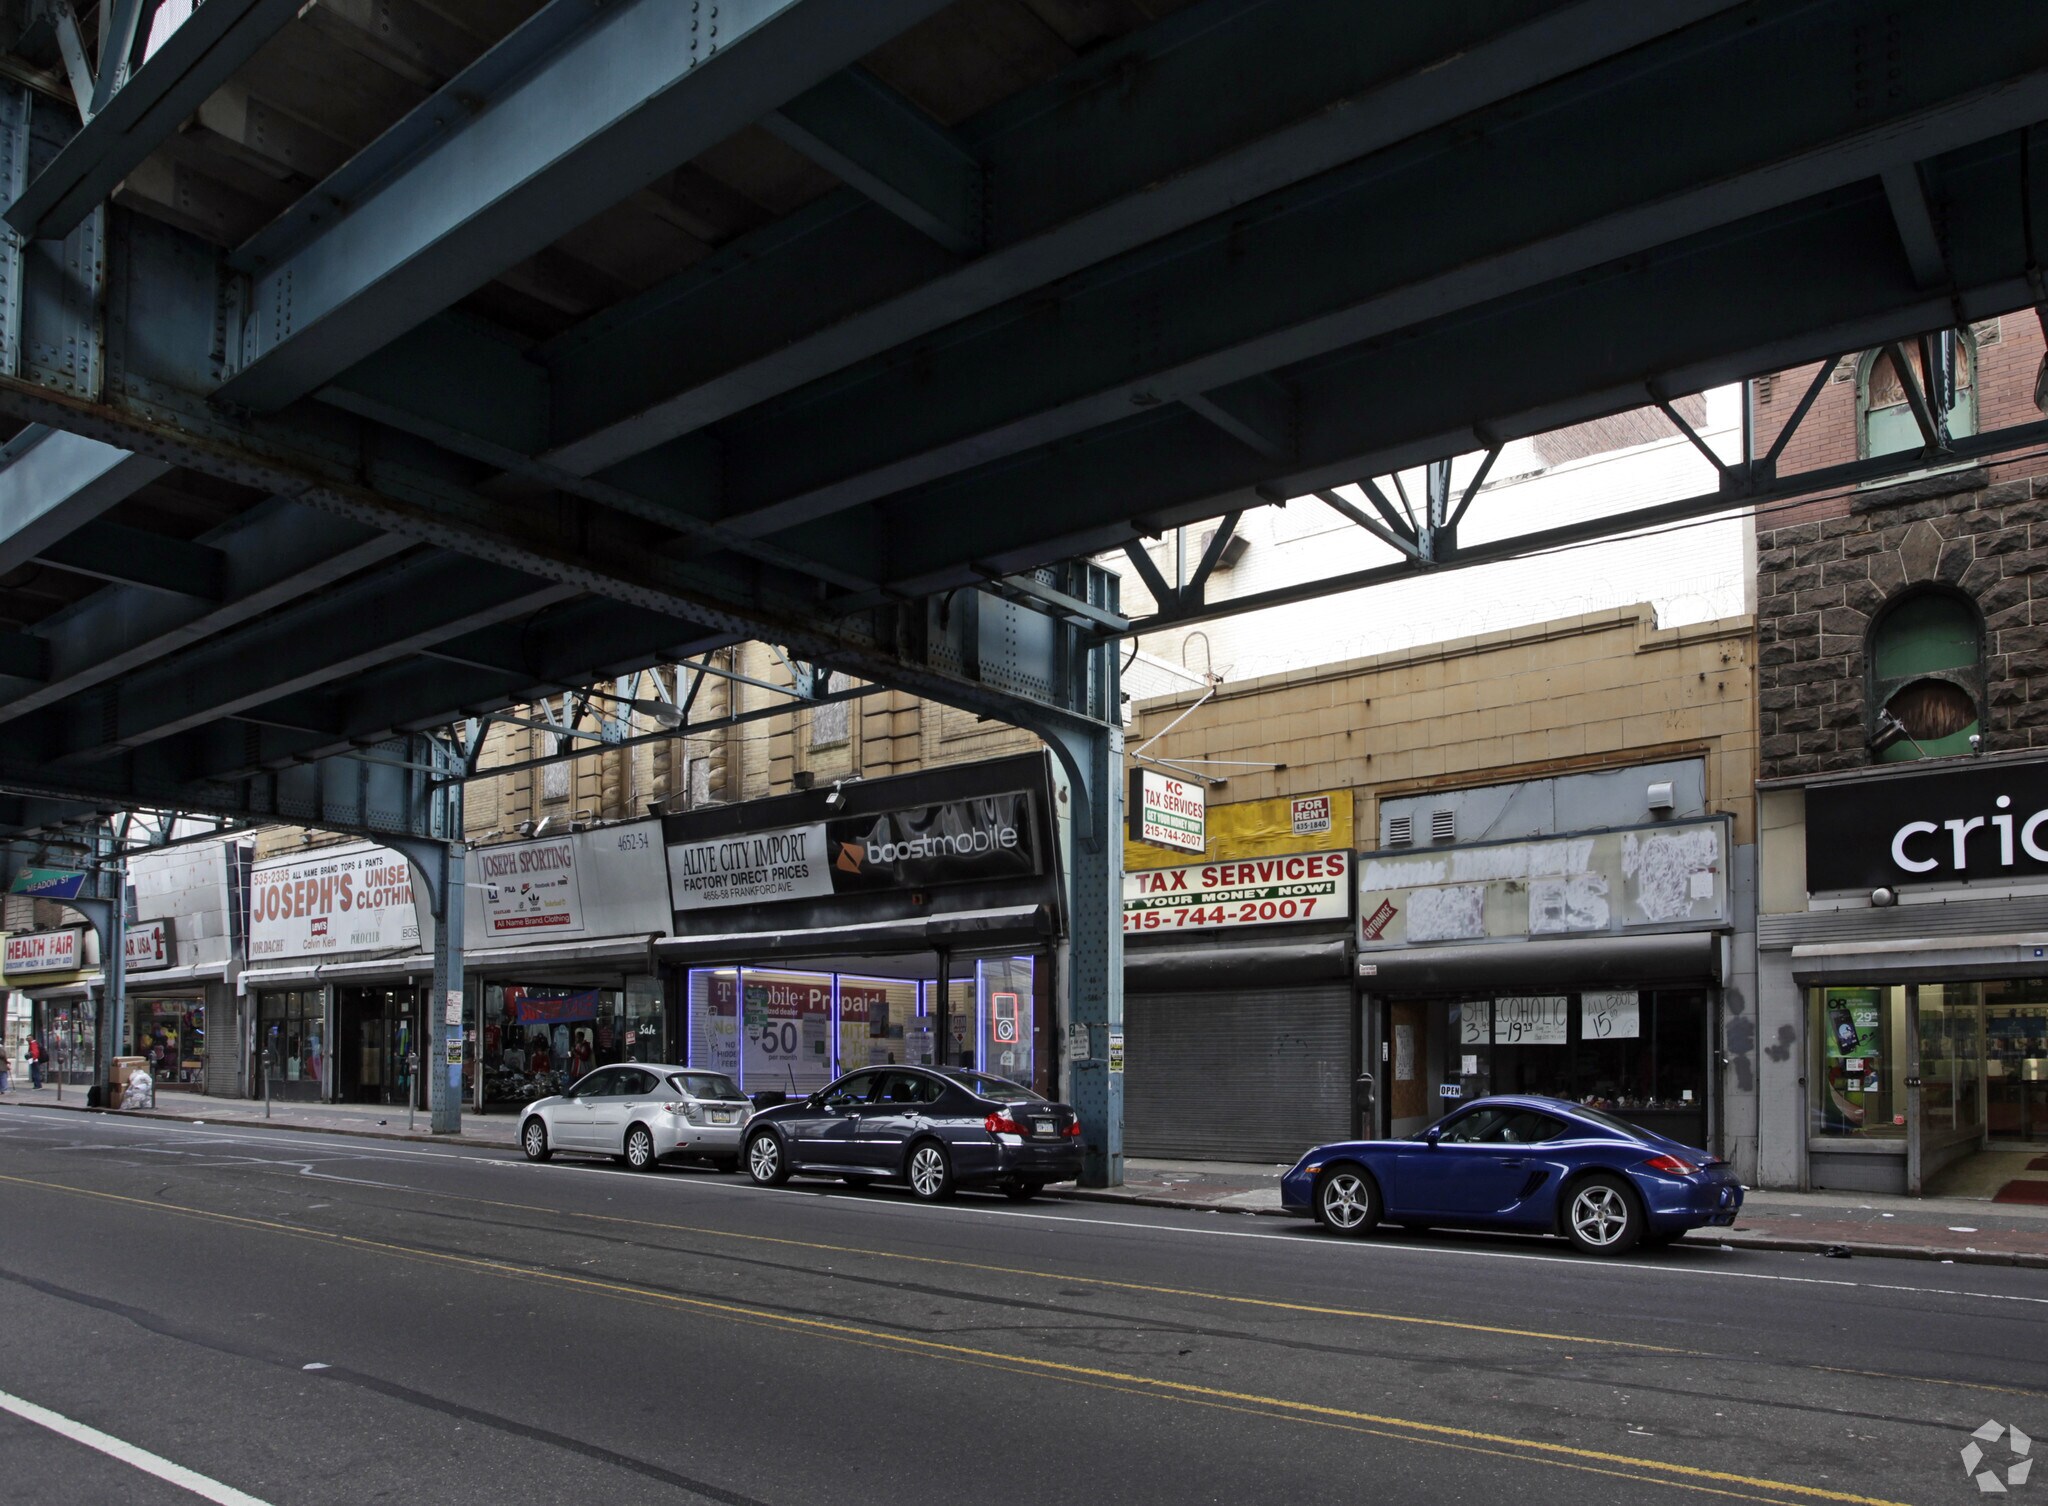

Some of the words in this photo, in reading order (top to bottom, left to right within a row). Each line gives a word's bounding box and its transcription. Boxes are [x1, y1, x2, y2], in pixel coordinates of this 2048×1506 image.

[1166, 780, 1183, 796] KC
[1145, 788, 1161, 807] TAX
[1164, 794, 1203, 818] SERVICES
[1298, 800, 1322, 811] FOR
[1295, 809, 1327, 821] RENT
[1145, 823, 1201, 846] 215-744-2007
[482, 852, 517, 882] JOSEPH
[519, 845, 571, 873] SPORTING
[683, 846, 717, 876] ALIVE
[720, 841, 749, 871] CITY
[753, 833, 807, 867] IMPORT
[254, 869, 290, 886] 535-2335
[293, 871, 302, 880] ALL
[304, 867, 318, 878] NAME
[320, 864, 338, 875] BRAND
[341, 861, 356, 871] TOPS
[365, 857, 384, 868] PANTS
[684, 874, 728, 891] FACTORY
[731, 869, 768, 886] DIRECT
[772, 864, 809, 880] PRICES
[1136, 869, 1188, 894] TAX
[1202, 854, 1345, 888] SERVICES
[254, 873, 353, 923] JOSEPH'S
[731, 883, 776, 898] FRANKFORD
[1144, 894, 1193, 906] YOUR
[1201, 887, 1269, 903] MONEY
[1278, 883, 1332, 896] NOW!
[525, 916, 543, 925] Brand
[544, 914, 570, 924] Clothing
[1364, 904, 1393, 939] ENTRANCE
[8, 938, 45, 960] HEALTH
[303, 938, 321, 951] Calvin
[809, 988, 880, 1017] Prpai
[1588, 998, 1606, 1016] ALL
[1828, 998, 1847, 1009] OR
[639, 1023, 656, 1035] Sale
[1441, 1085, 1460, 1096] OPEN
